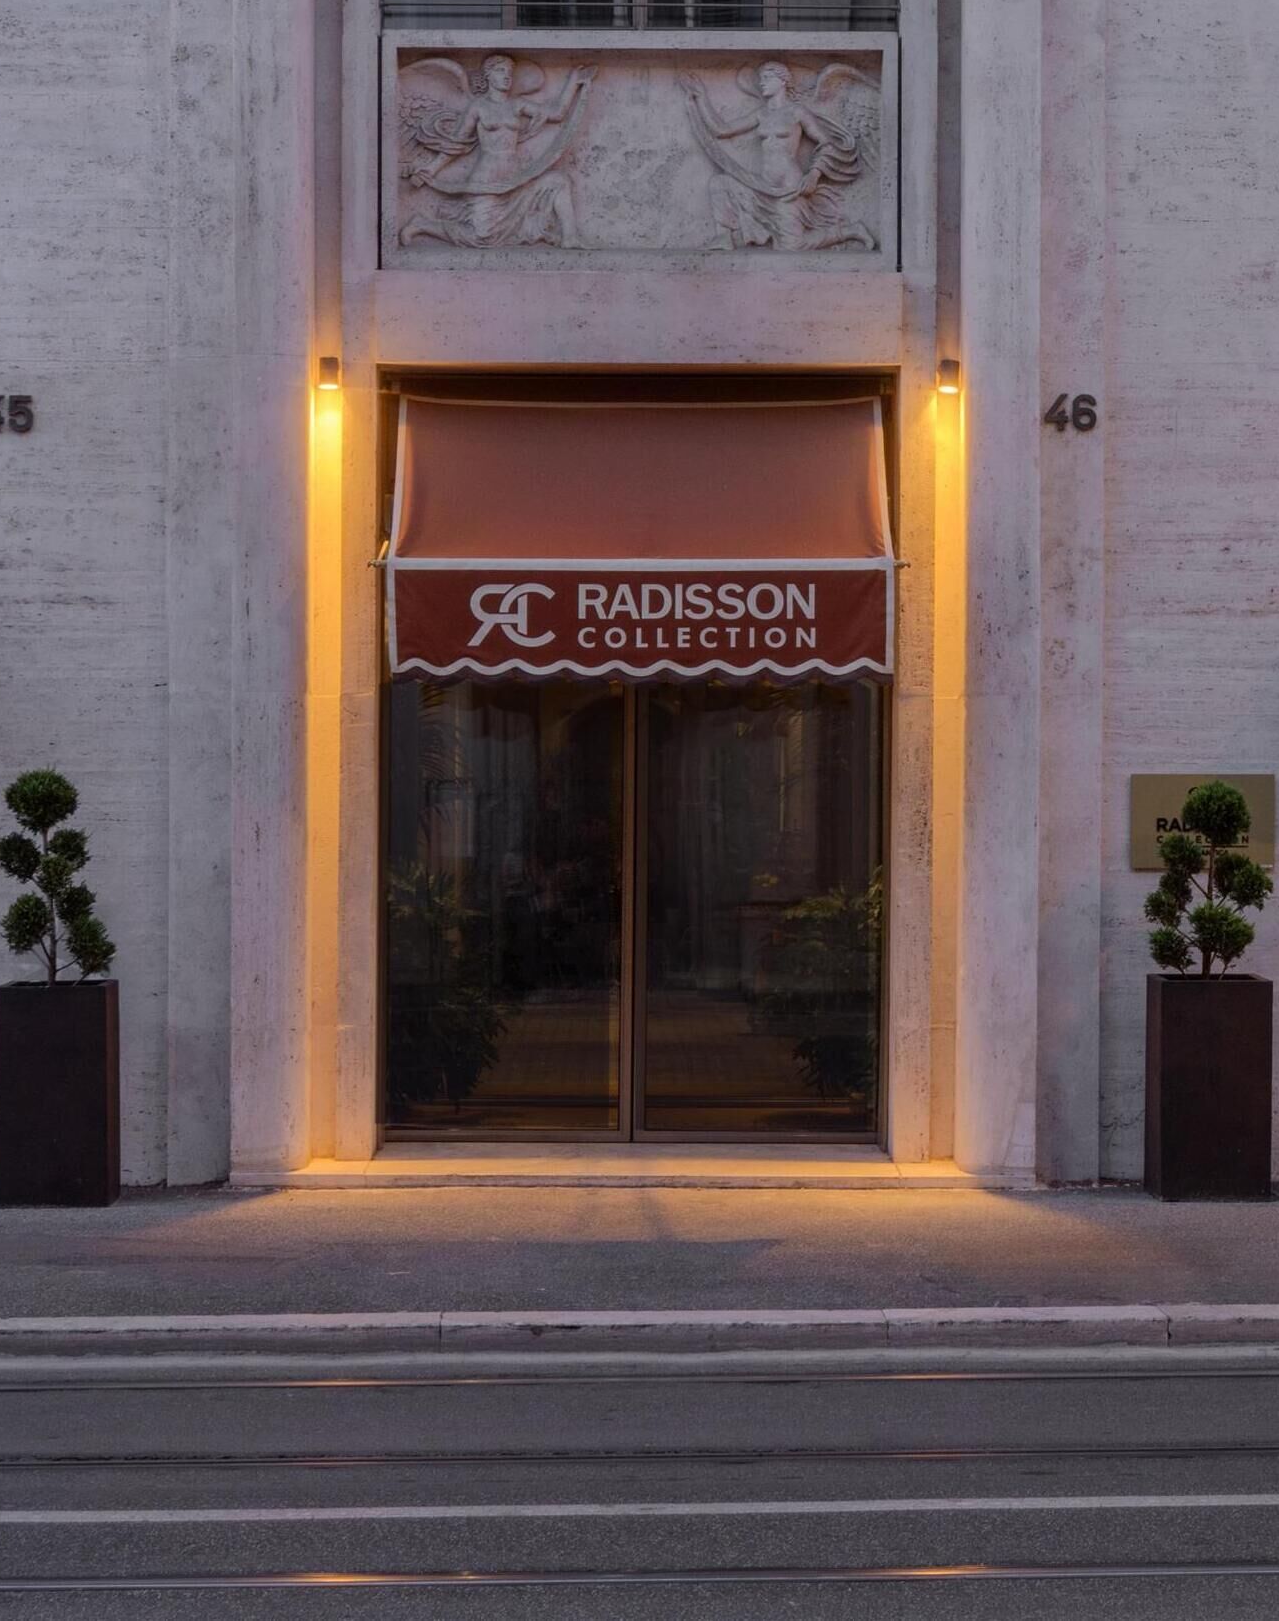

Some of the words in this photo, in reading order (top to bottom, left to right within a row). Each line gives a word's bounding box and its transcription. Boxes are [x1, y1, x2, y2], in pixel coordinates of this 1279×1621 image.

[1043, 393, 1098, 433] 46
[577, 583, 816, 620] RADISSON
[577, 626, 817, 649] COLLECTION
